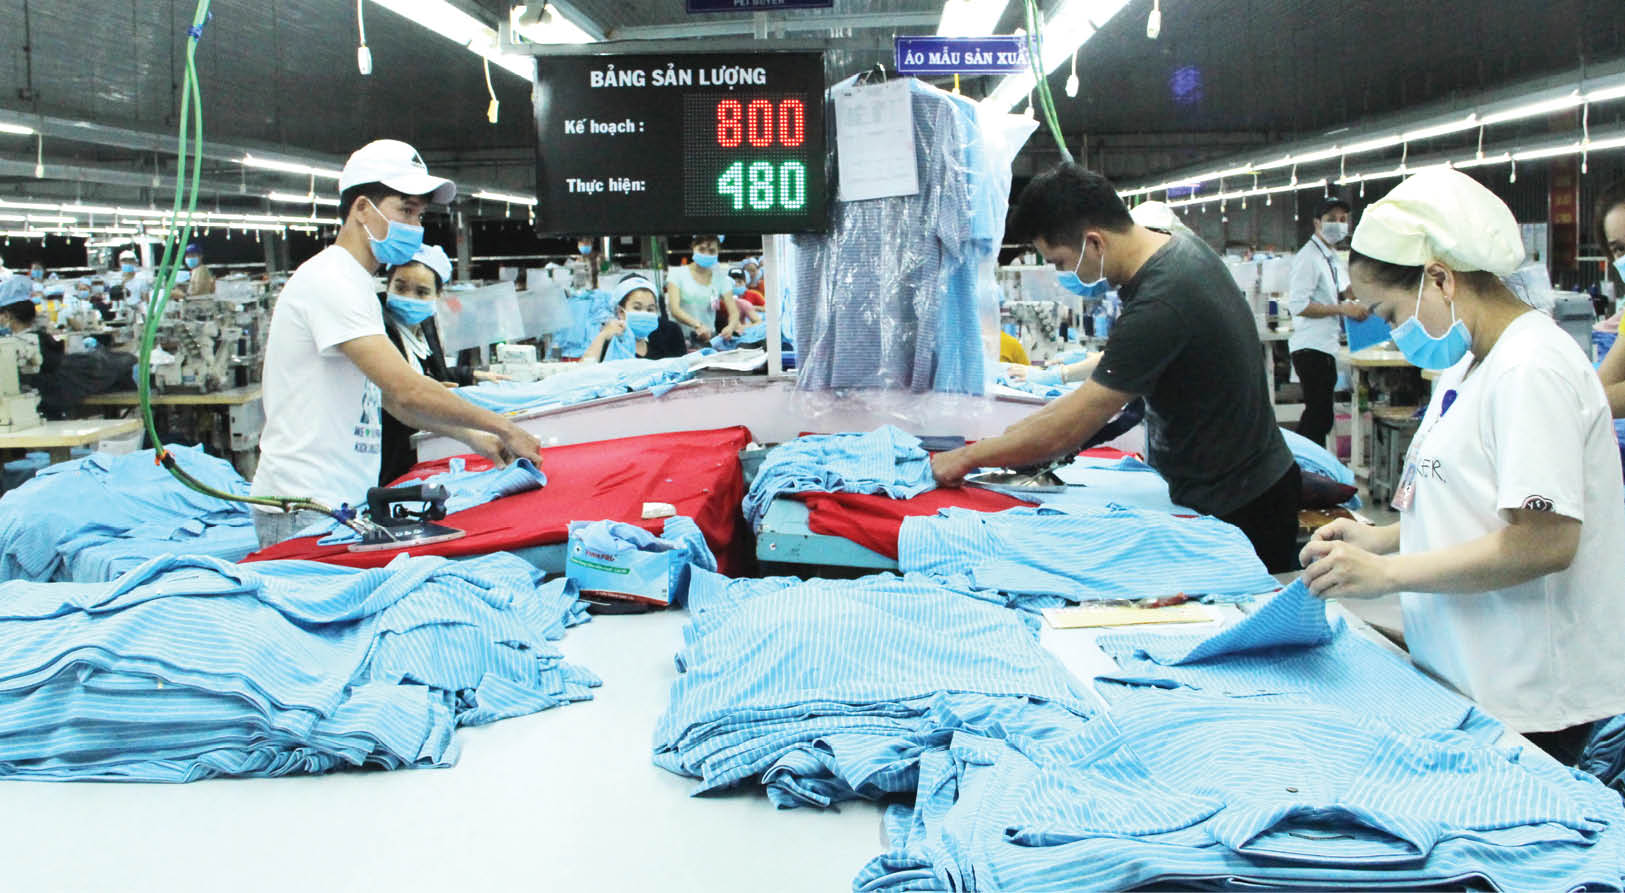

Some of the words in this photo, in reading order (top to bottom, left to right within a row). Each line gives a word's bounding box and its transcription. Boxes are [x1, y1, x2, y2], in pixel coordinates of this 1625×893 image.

[904, 49, 924, 65] ÁO
[928, 46, 960, 65] MẪU
[964, 47, 993, 65] SẢN
[590, 64, 646, 88] BẢNG
[651, 62, 692, 87] SẢN
[699, 65, 766, 90] LƯỢNG
[564, 118, 587, 135] Kế
[590, 118, 635, 136] hoạch
[717, 99, 804, 147] 800
[566, 178, 604, 196] Thực
[608, 177, 646, 195] hiện:
[717, 161, 805, 209] 480
